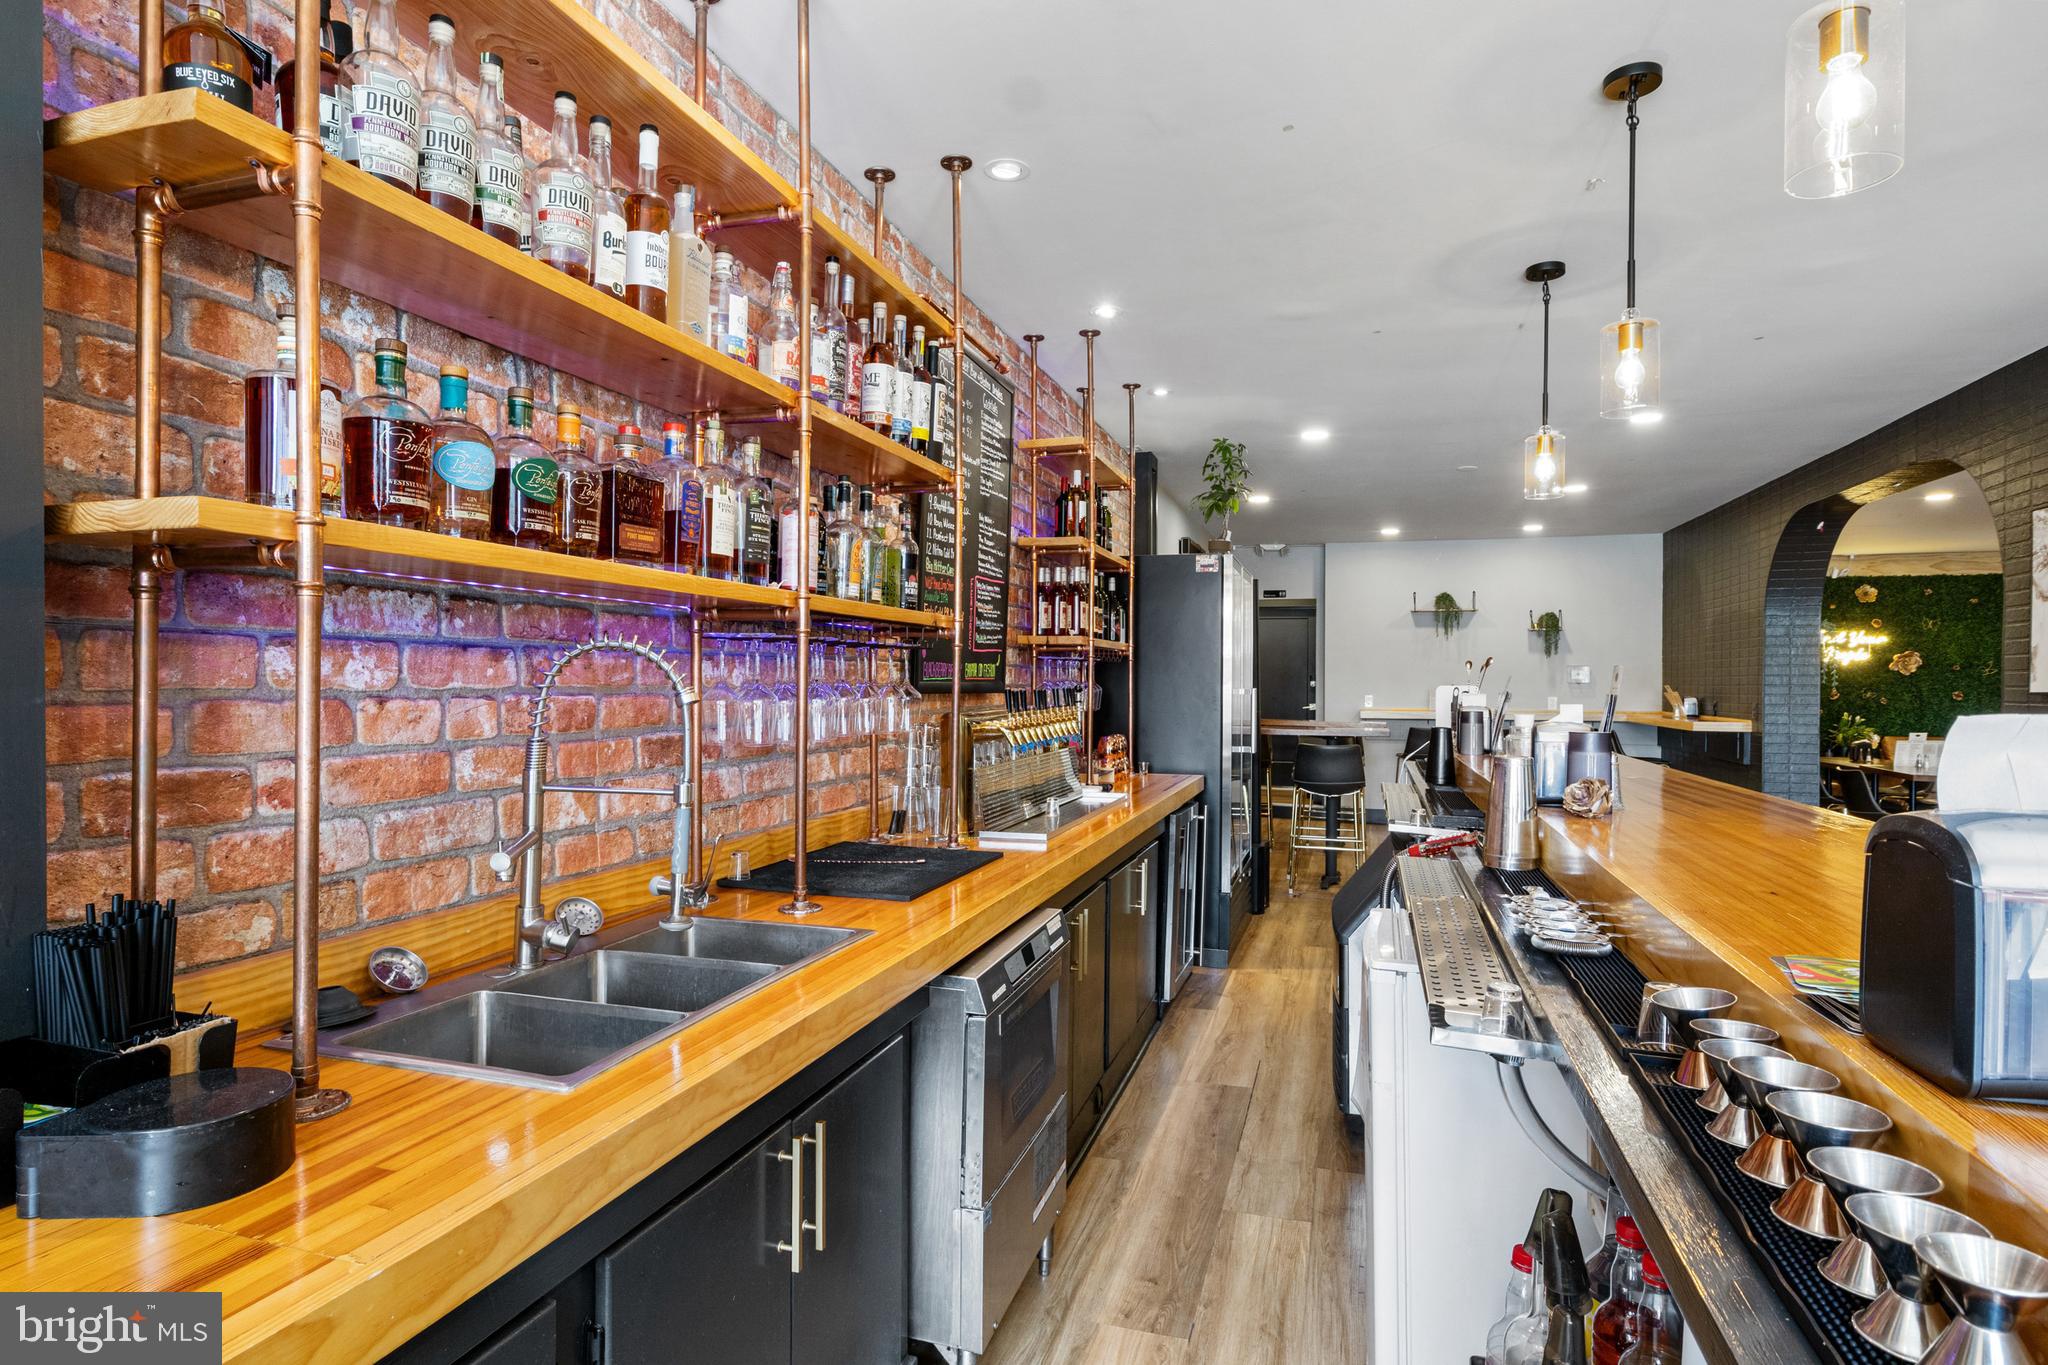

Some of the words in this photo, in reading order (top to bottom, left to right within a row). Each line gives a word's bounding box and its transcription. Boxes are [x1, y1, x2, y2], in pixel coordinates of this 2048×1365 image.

[175, 66, 193, 78] BLUE
[196, 67, 219, 83] EYED
[220, 75, 236, 89] SIX
[366, 91, 417, 127] DAVID
[426, 129, 473, 160] DAVID
[548, 188, 590, 213] DAVID
